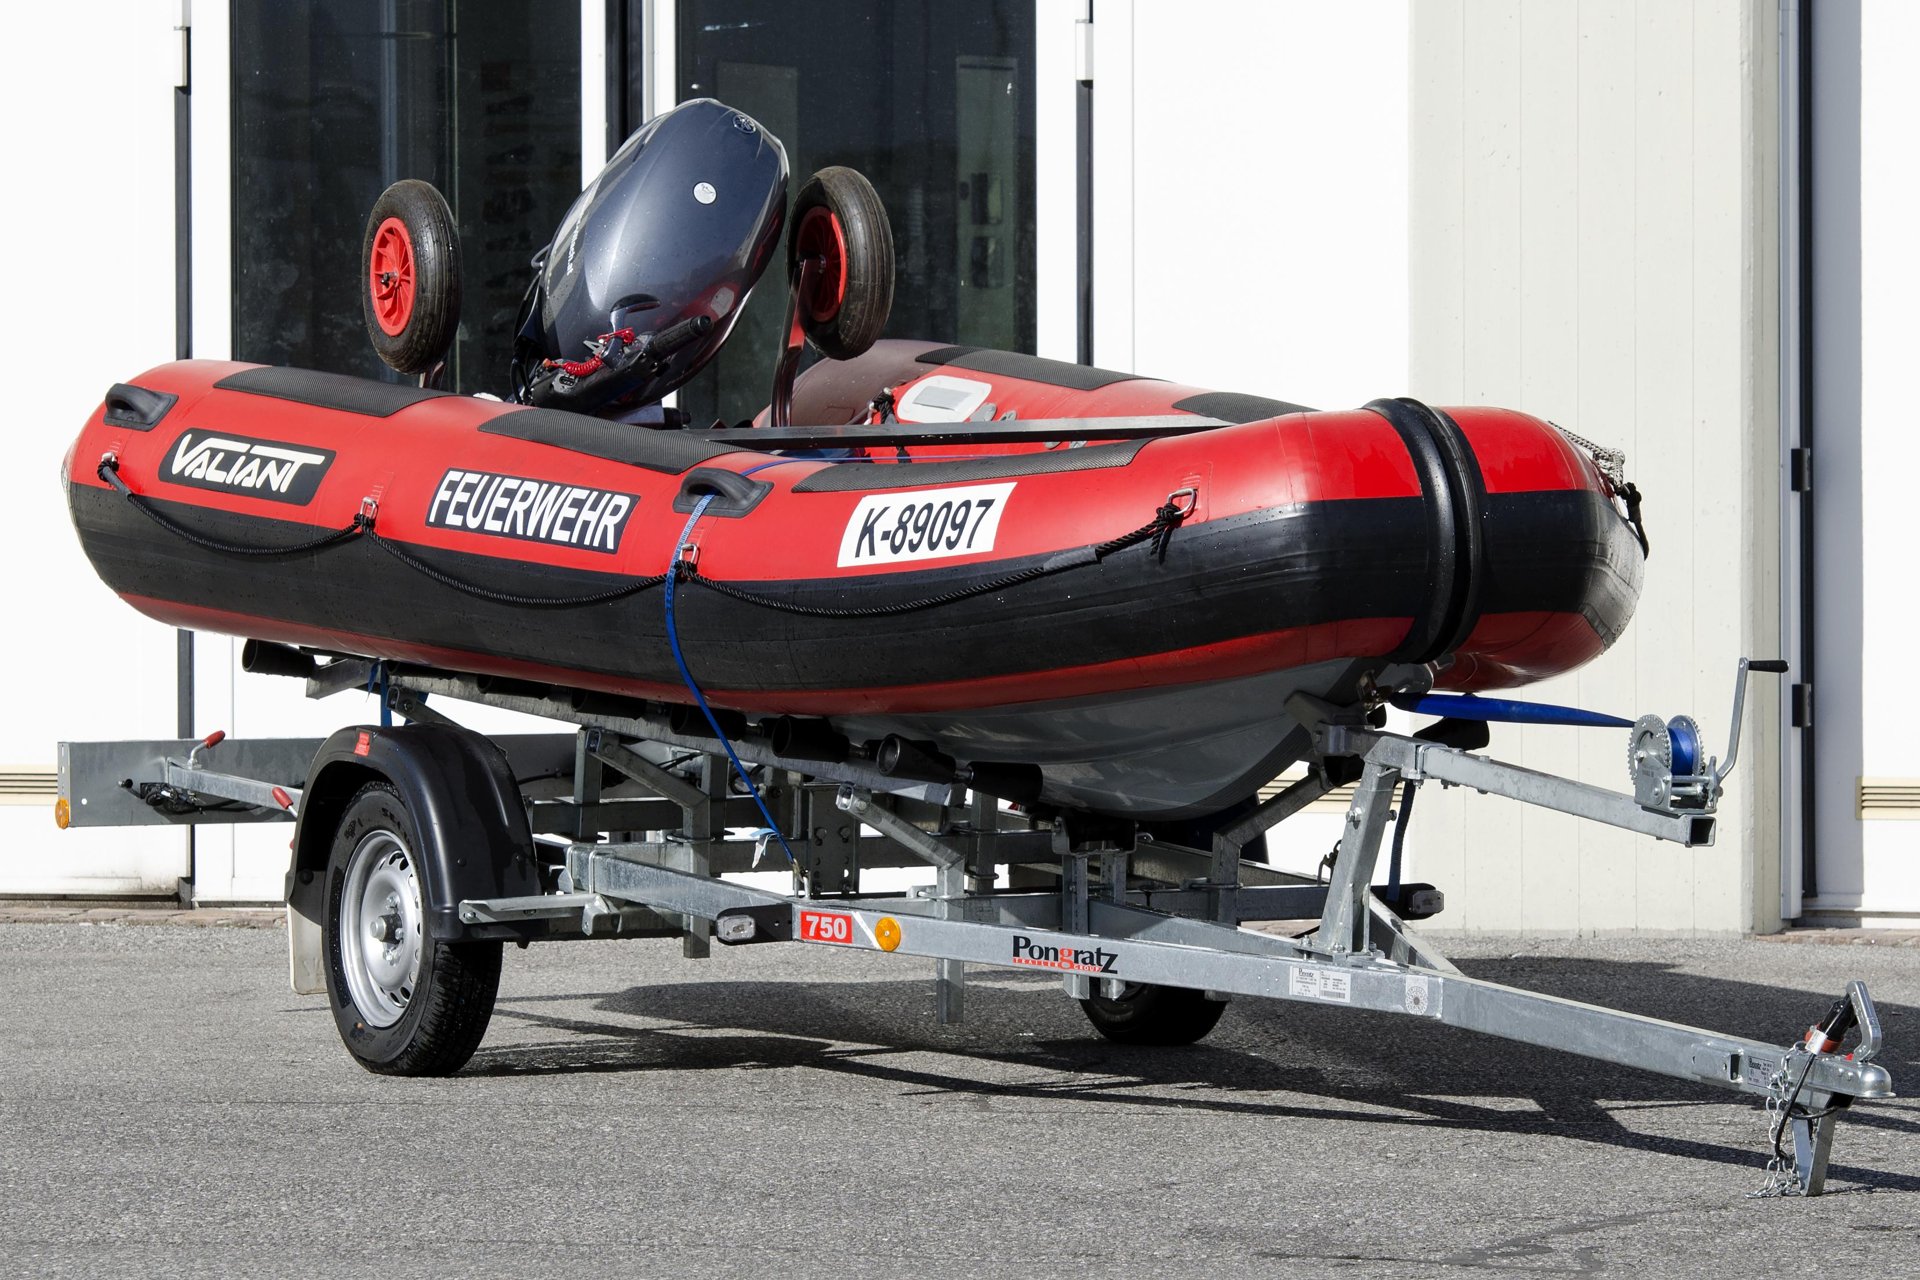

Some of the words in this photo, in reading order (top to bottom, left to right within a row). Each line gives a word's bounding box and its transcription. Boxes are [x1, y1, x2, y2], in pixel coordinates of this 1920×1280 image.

[170, 433, 326, 493] VALIANT
[429, 470, 631, 550] FEUERWEHR
[855, 498, 996, 558] K-89097
[806, 915, 847, 940] 750
[1013, 935, 1118, 974] Pongratz
[1073, 964, 1101, 973] GROUP
